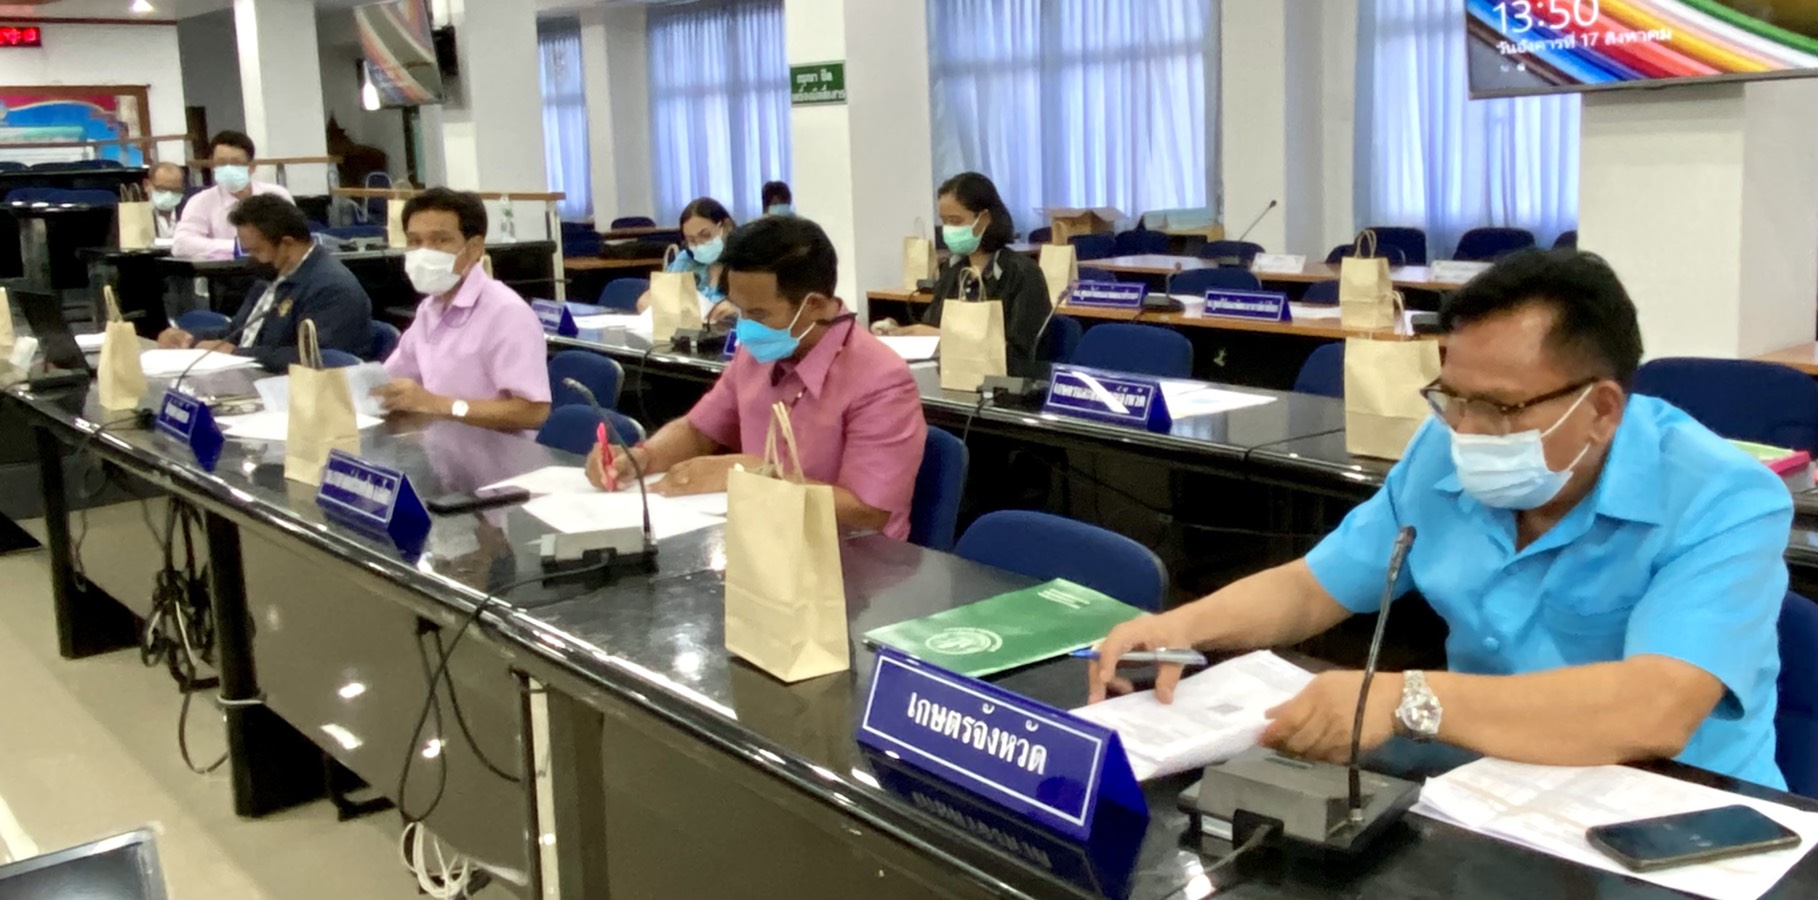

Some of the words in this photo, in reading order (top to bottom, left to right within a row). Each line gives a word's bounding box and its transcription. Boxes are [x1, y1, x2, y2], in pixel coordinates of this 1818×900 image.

[1492, 0, 1599, 34] 13:50
[1496, 32, 1575, 56] วันอังคารที่
[1580, 32, 1599, 48] 17
[1604, 28, 1673, 46] สิงหาคม
[906, 691, 1049, 776] เกษตรจังหวัด
